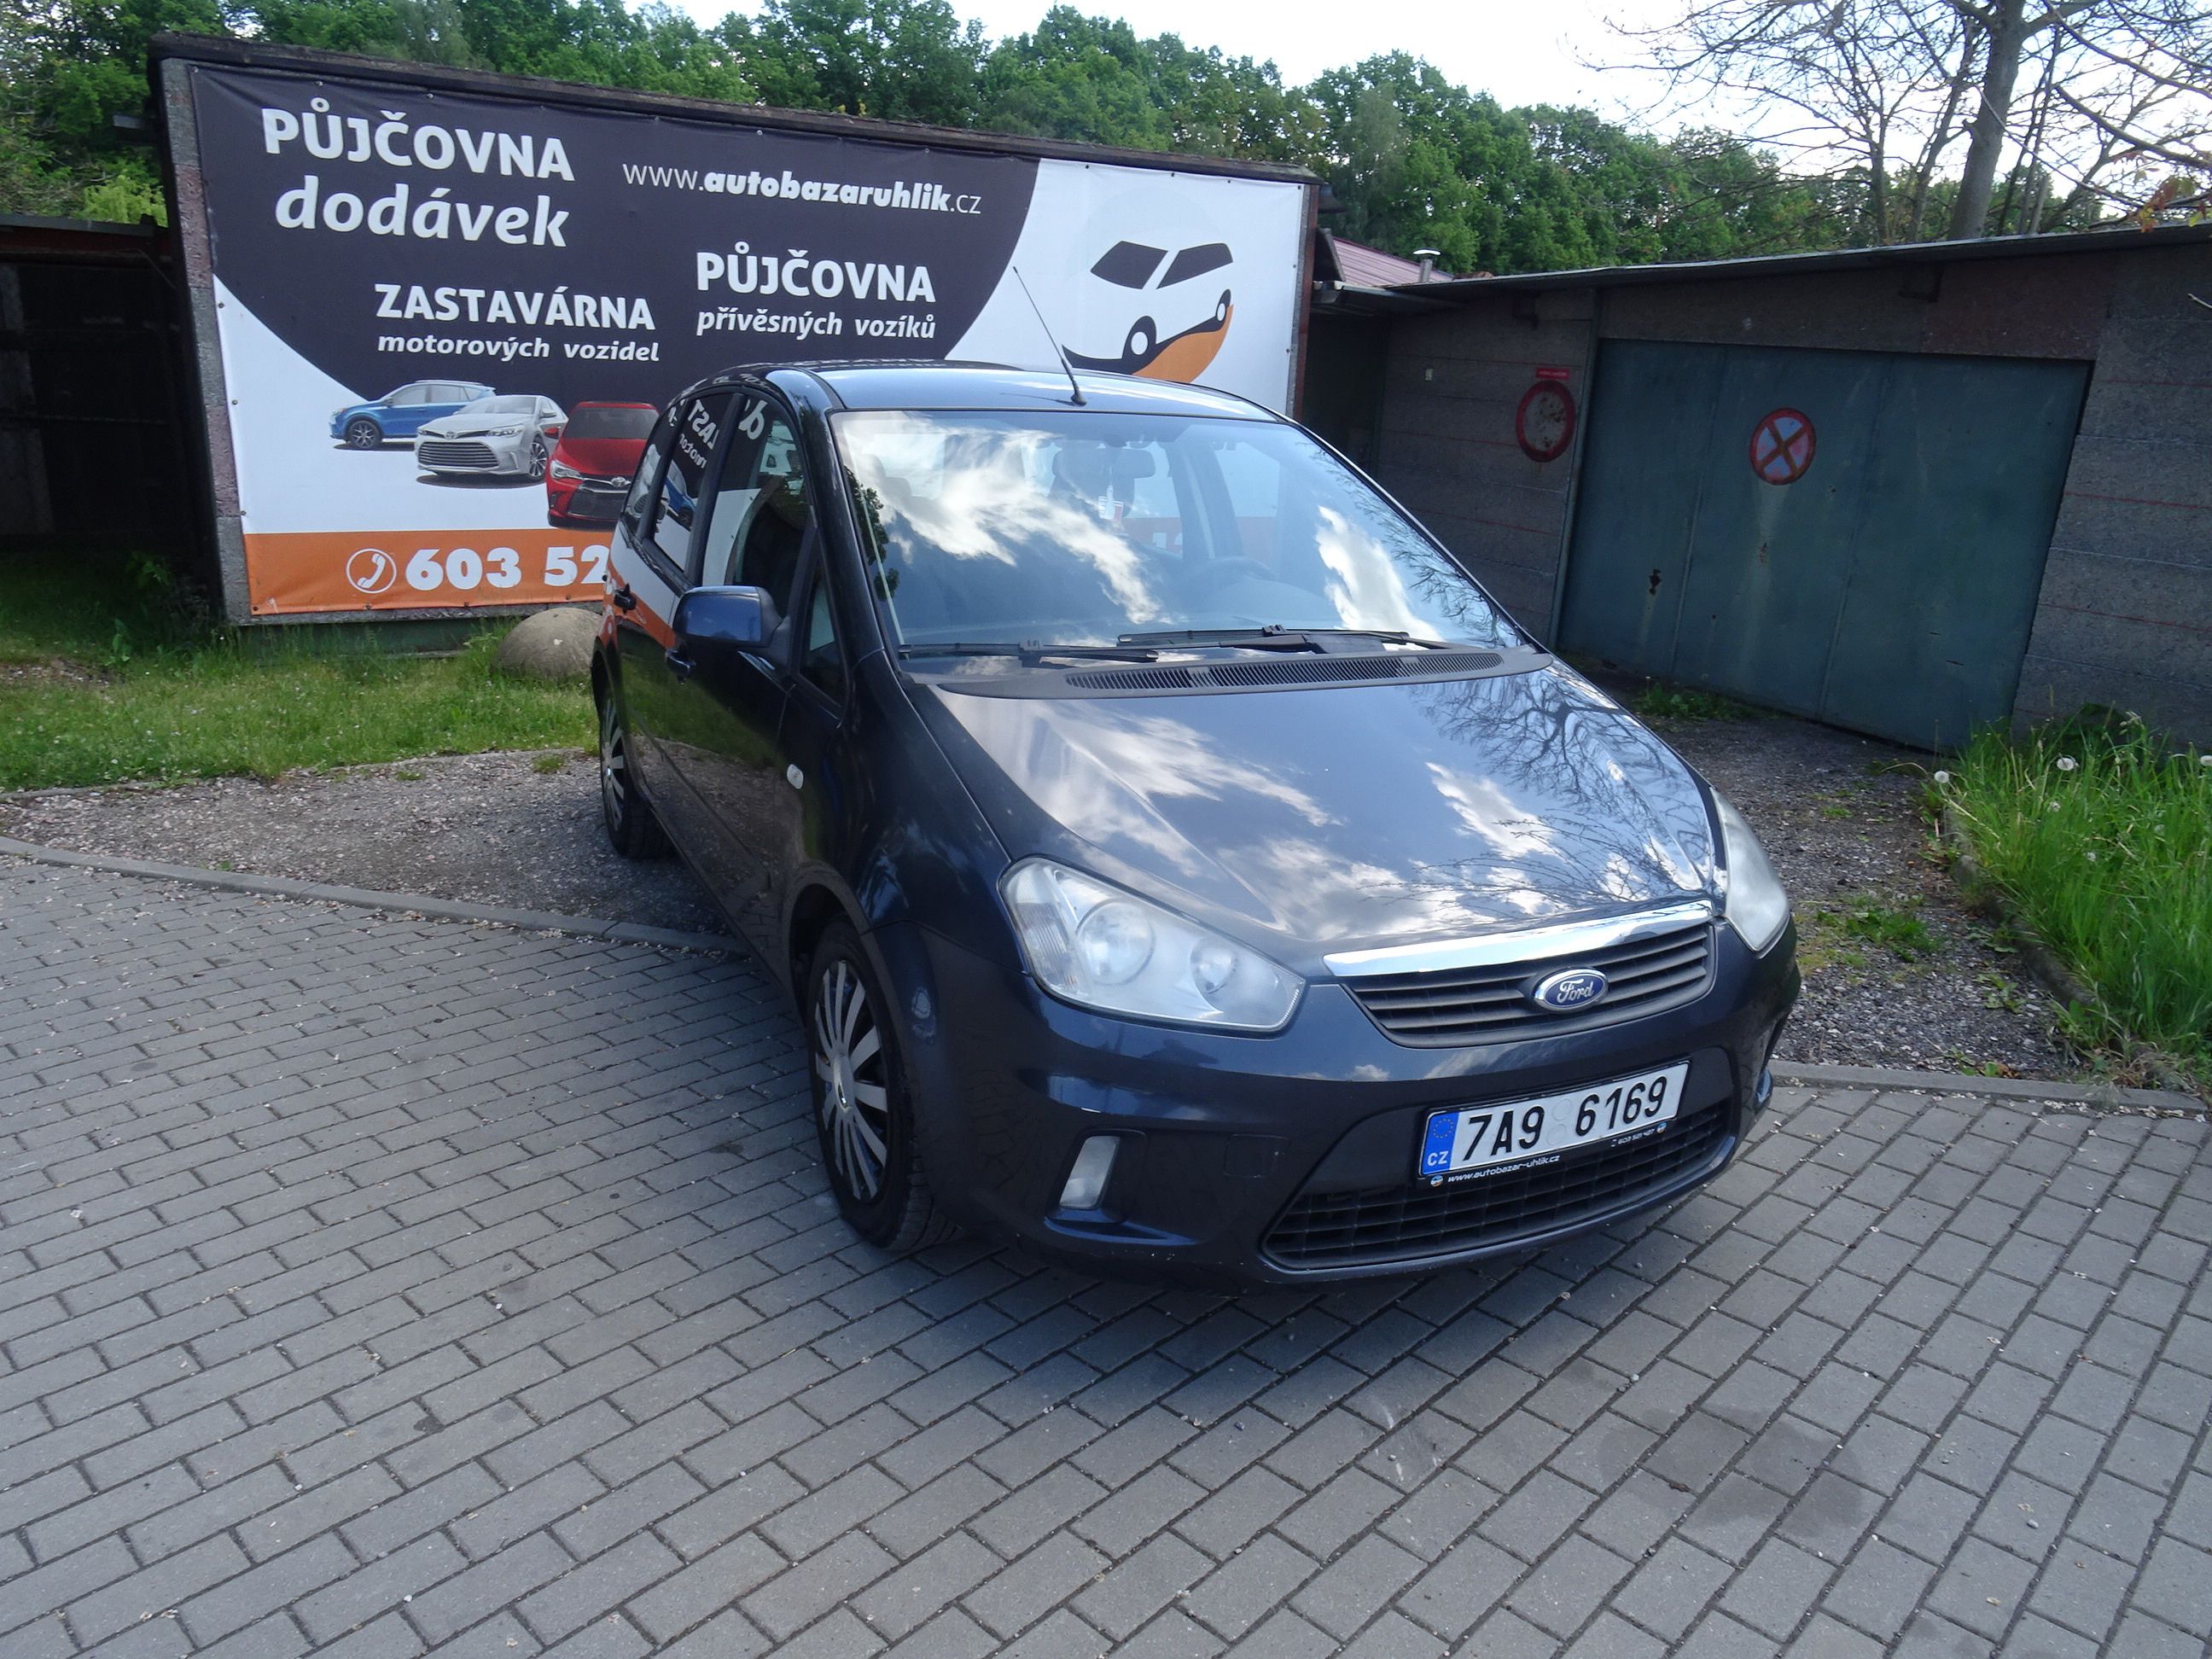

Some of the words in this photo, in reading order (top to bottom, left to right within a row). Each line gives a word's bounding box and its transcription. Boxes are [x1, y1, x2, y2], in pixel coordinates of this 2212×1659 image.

[262, 96, 575, 183] PŮJČOVNA
[275, 174, 571, 247] dodávek
[623, 163, 982, 215] www.autobazaruhlik.cz
[696, 242, 936, 303] PŮJČOVNA
[375, 284, 655, 330] ZASTAVÁRNA
[696, 307, 842, 341] přívěsných
[855, 314, 936, 339] vozíků
[378, 334, 550, 362] motorových
[564, 341, 660, 362] vozidel
[405, 547, 522, 591] 603
[1556, 978, 1595, 1004] Ford
[1462, 1105, 1545, 1161] 7A9
[1575, 1075, 1668, 1137] 6169
[1427, 1150, 1449, 1167] CZ
[1447, 1155, 1561, 1183] www.autobazar-uhlik.cz
